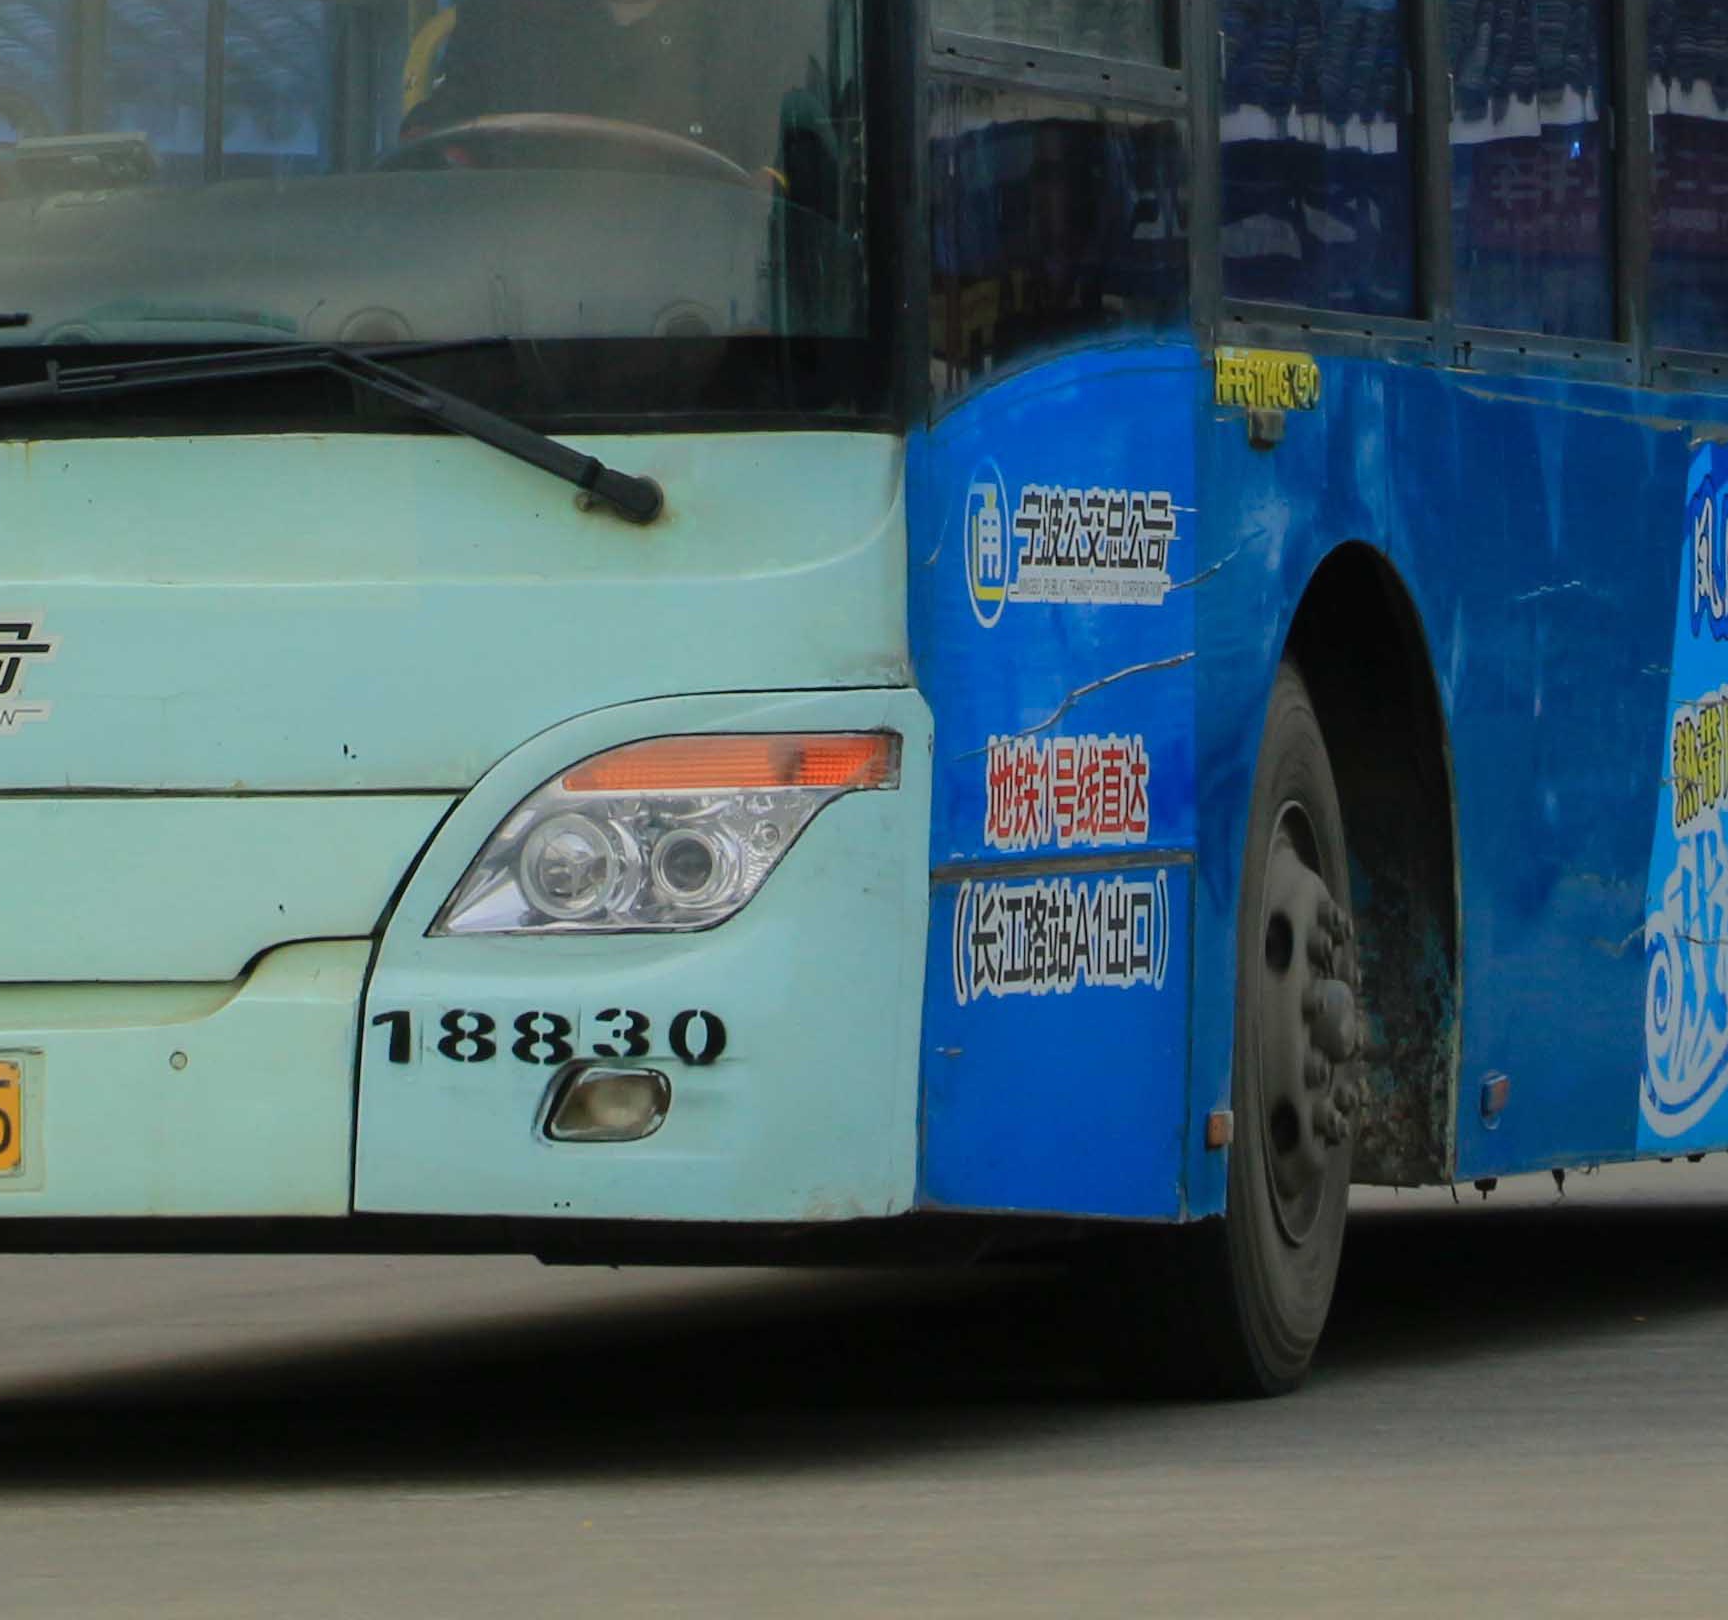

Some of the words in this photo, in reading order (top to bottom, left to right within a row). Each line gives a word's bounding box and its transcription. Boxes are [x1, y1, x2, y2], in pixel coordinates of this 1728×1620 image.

[1014, 490, 1174, 571] 宁波公交总公司
[986, 739, 1148, 843] 地铁1号线直达
[952, 870, 1169, 1002] (长江路站A1出口)
[371, 1007, 729, 1067] 18830
